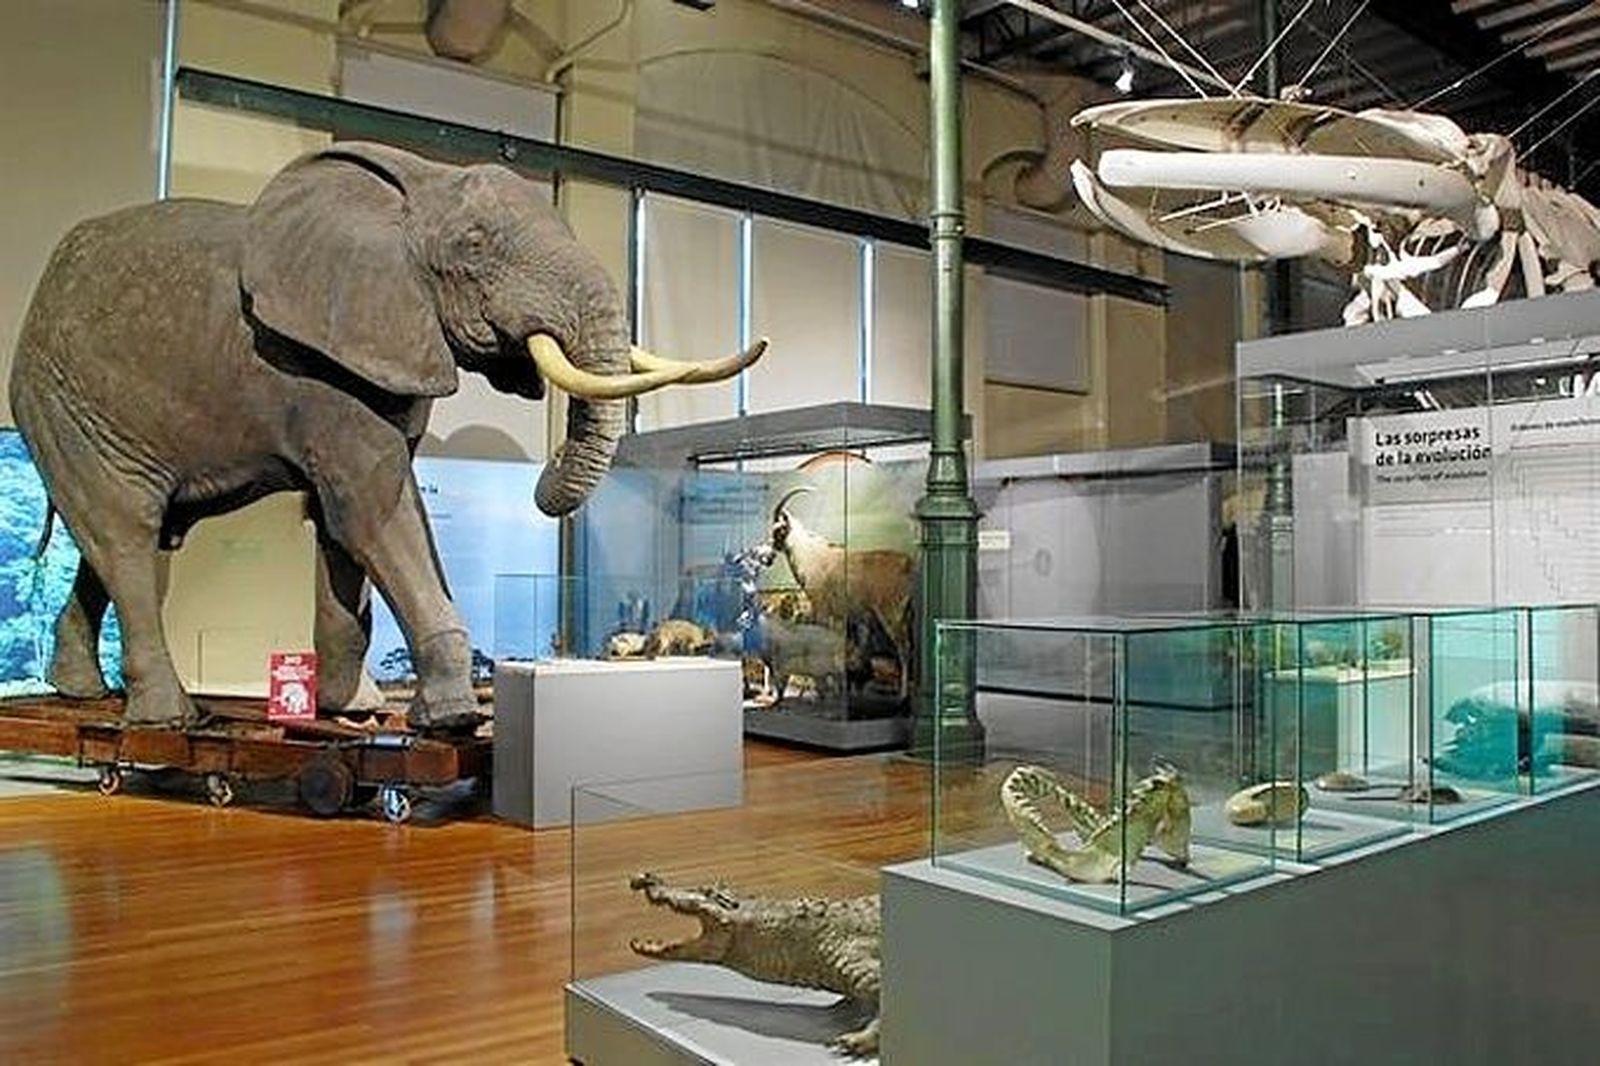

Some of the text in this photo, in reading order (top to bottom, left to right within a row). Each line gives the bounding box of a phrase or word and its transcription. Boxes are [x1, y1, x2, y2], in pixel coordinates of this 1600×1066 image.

[1375, 426, 1482, 447] Las sorpresas
[1375, 451, 1394, 467] de
[1397, 450, 1412, 465] la
